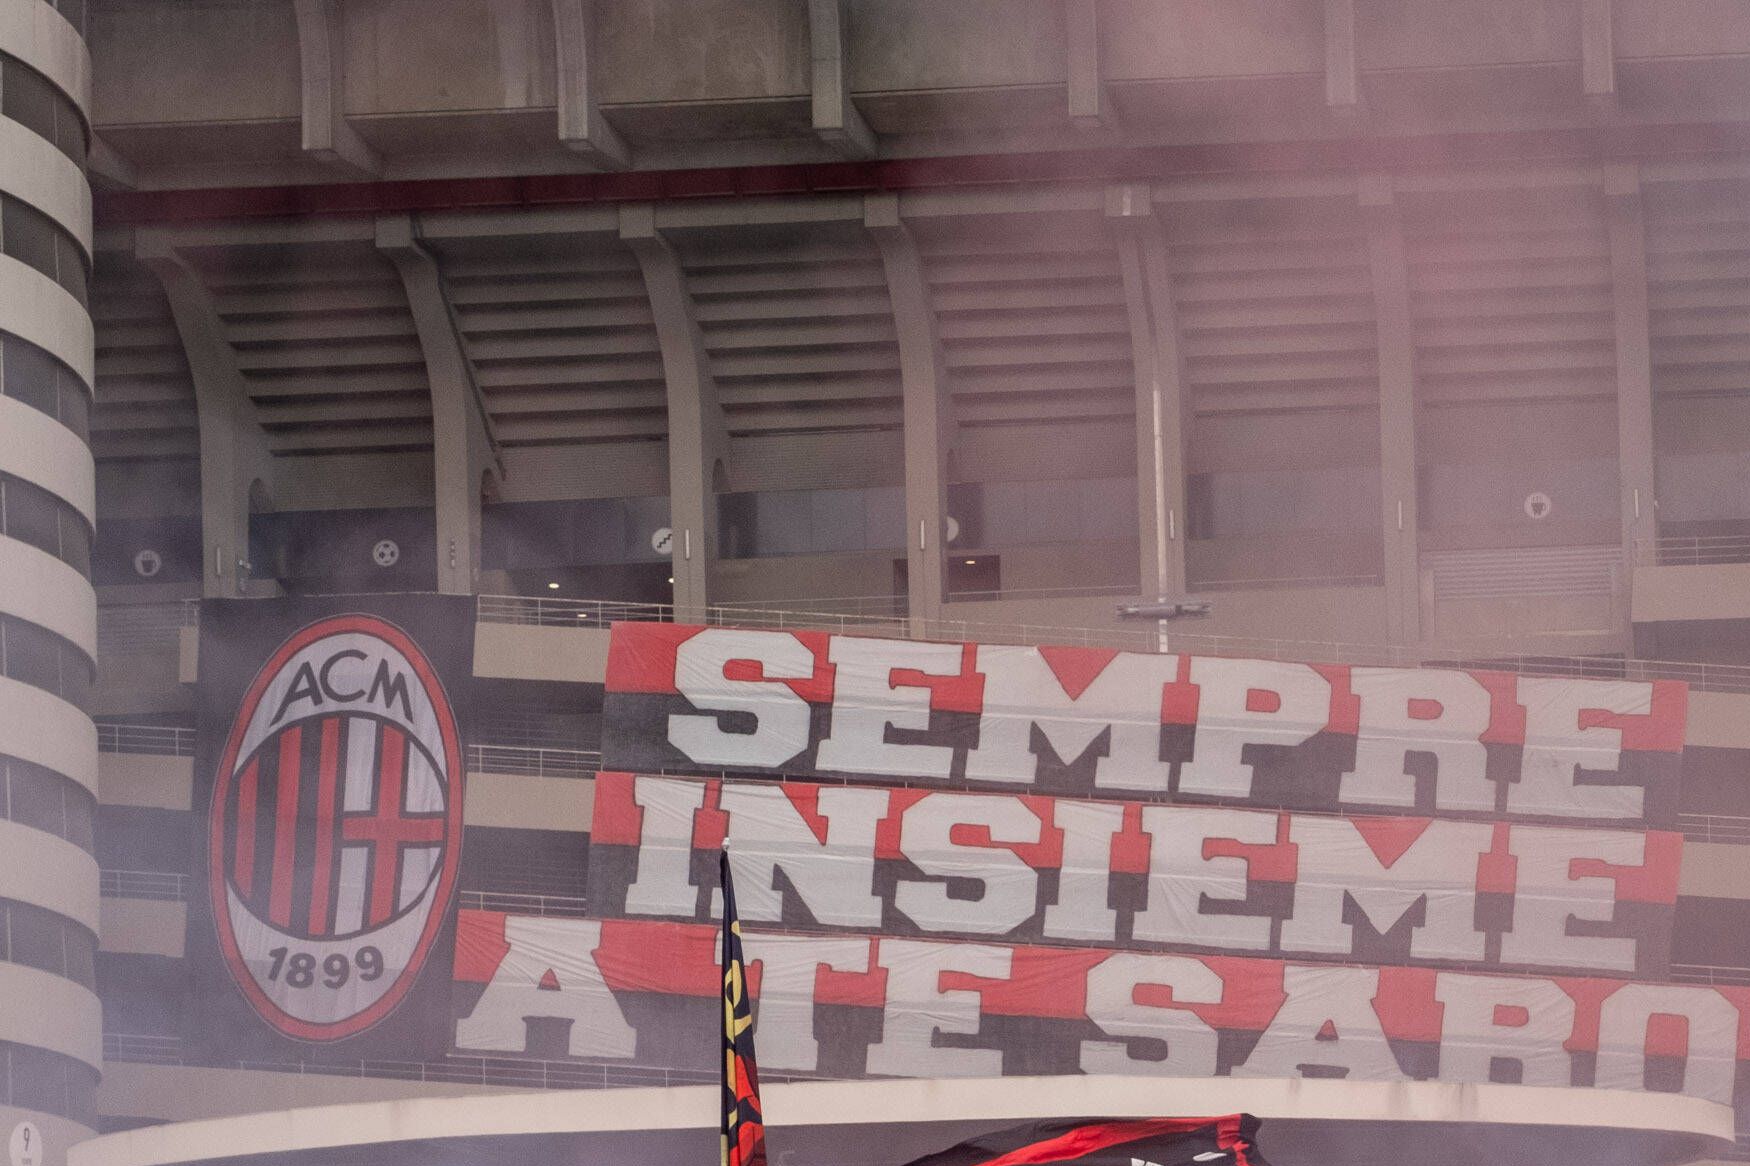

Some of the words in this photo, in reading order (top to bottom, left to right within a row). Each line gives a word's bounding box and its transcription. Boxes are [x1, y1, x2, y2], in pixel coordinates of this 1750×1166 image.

[269, 648, 415, 727] ACM
[667, 627, 1654, 820] SEMPRE
[625, 775, 1646, 973] INSIEME
[266, 944, 384, 993] 1899
[455, 915, 638, 1059] A
[715, 929, 1013, 1078] TE
